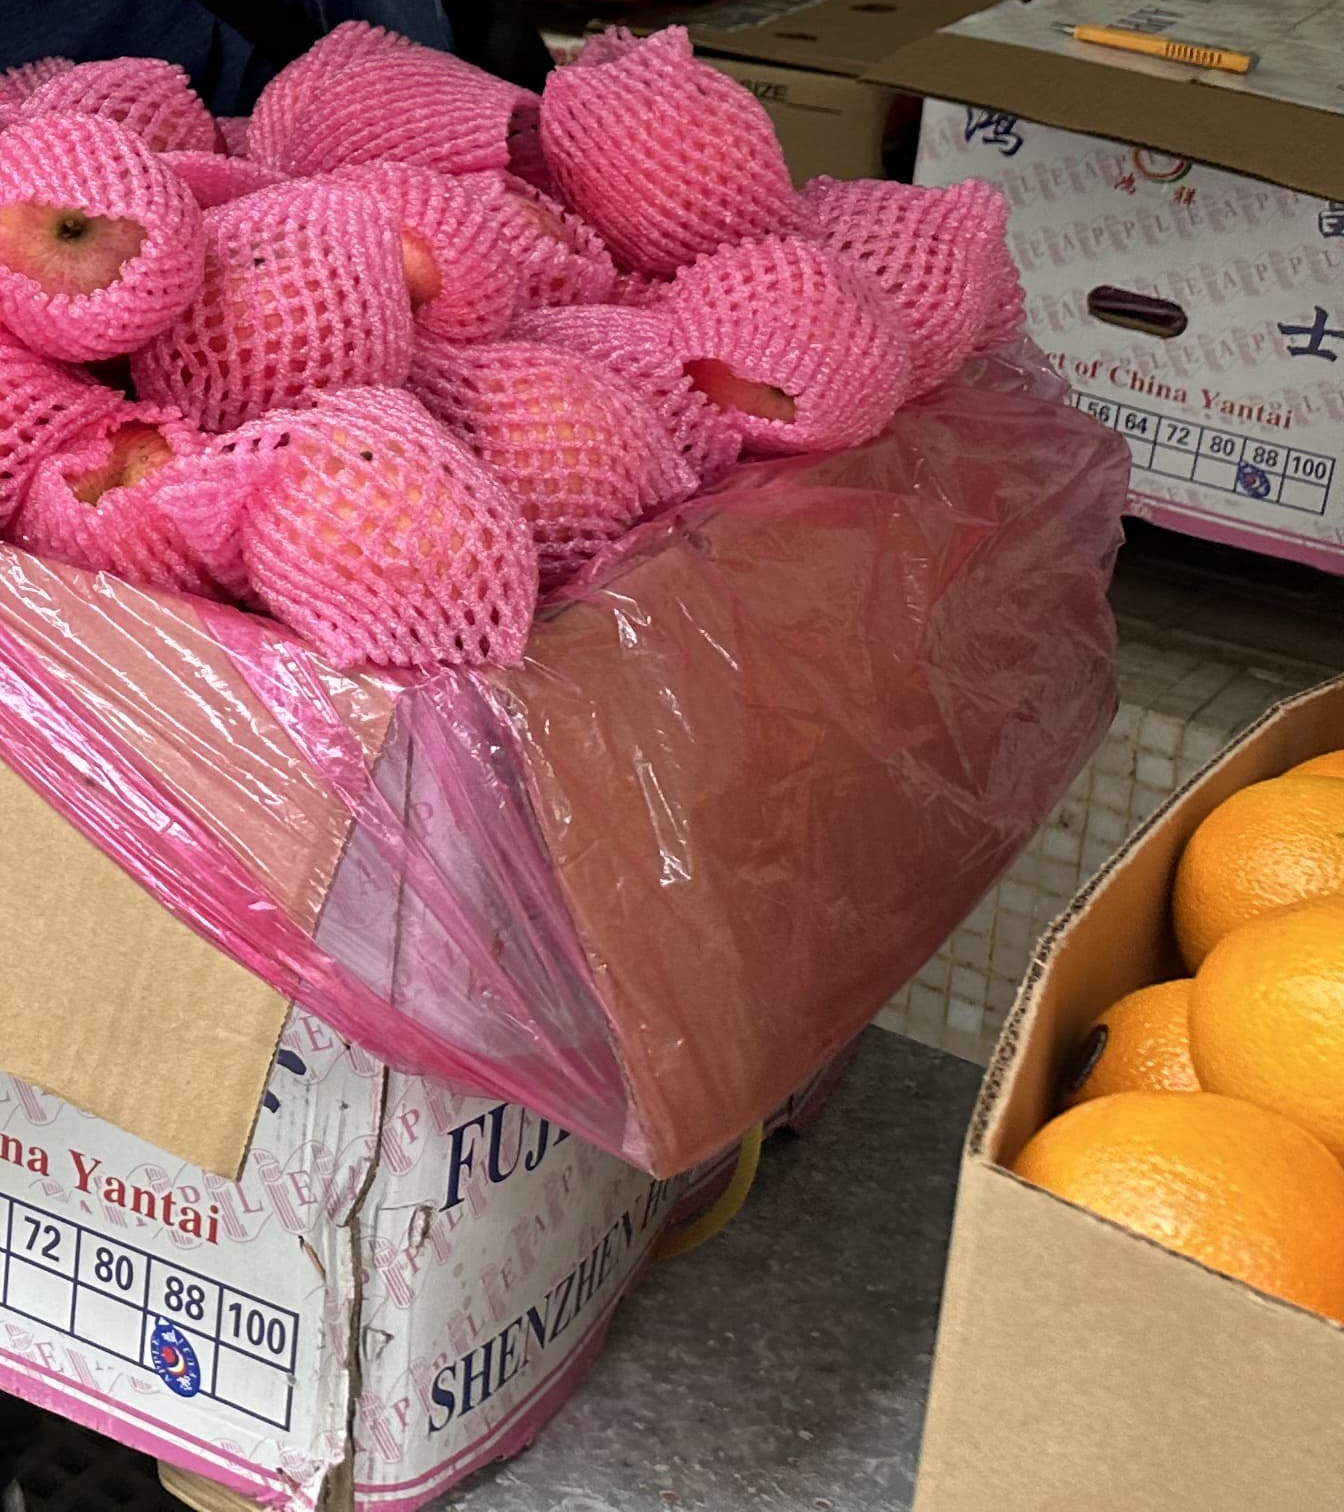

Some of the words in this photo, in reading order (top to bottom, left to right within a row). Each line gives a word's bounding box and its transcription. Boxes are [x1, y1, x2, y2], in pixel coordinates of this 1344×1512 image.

[1075, 359, 1102, 379] of
[1112, 364, 1188, 405] China
[1201, 388, 1294, 430] Yantai
[1123, 410, 1149, 436] 64
[1166, 423, 1192, 447] 72
[1209, 434, 1236, 458] 80
[1252, 445, 1280, 469] 88
[1292, 455, 1328, 481] 100
[68, 1148, 221, 1245] Yantai
[23, 1216, 62, 1262] 72
[93, 1246, 135, 1290] 80
[164, 1276, 206, 1321] 88
[228, 1302, 286, 1355] 100
[426, 1209, 633, 1435] SHENZHEN
